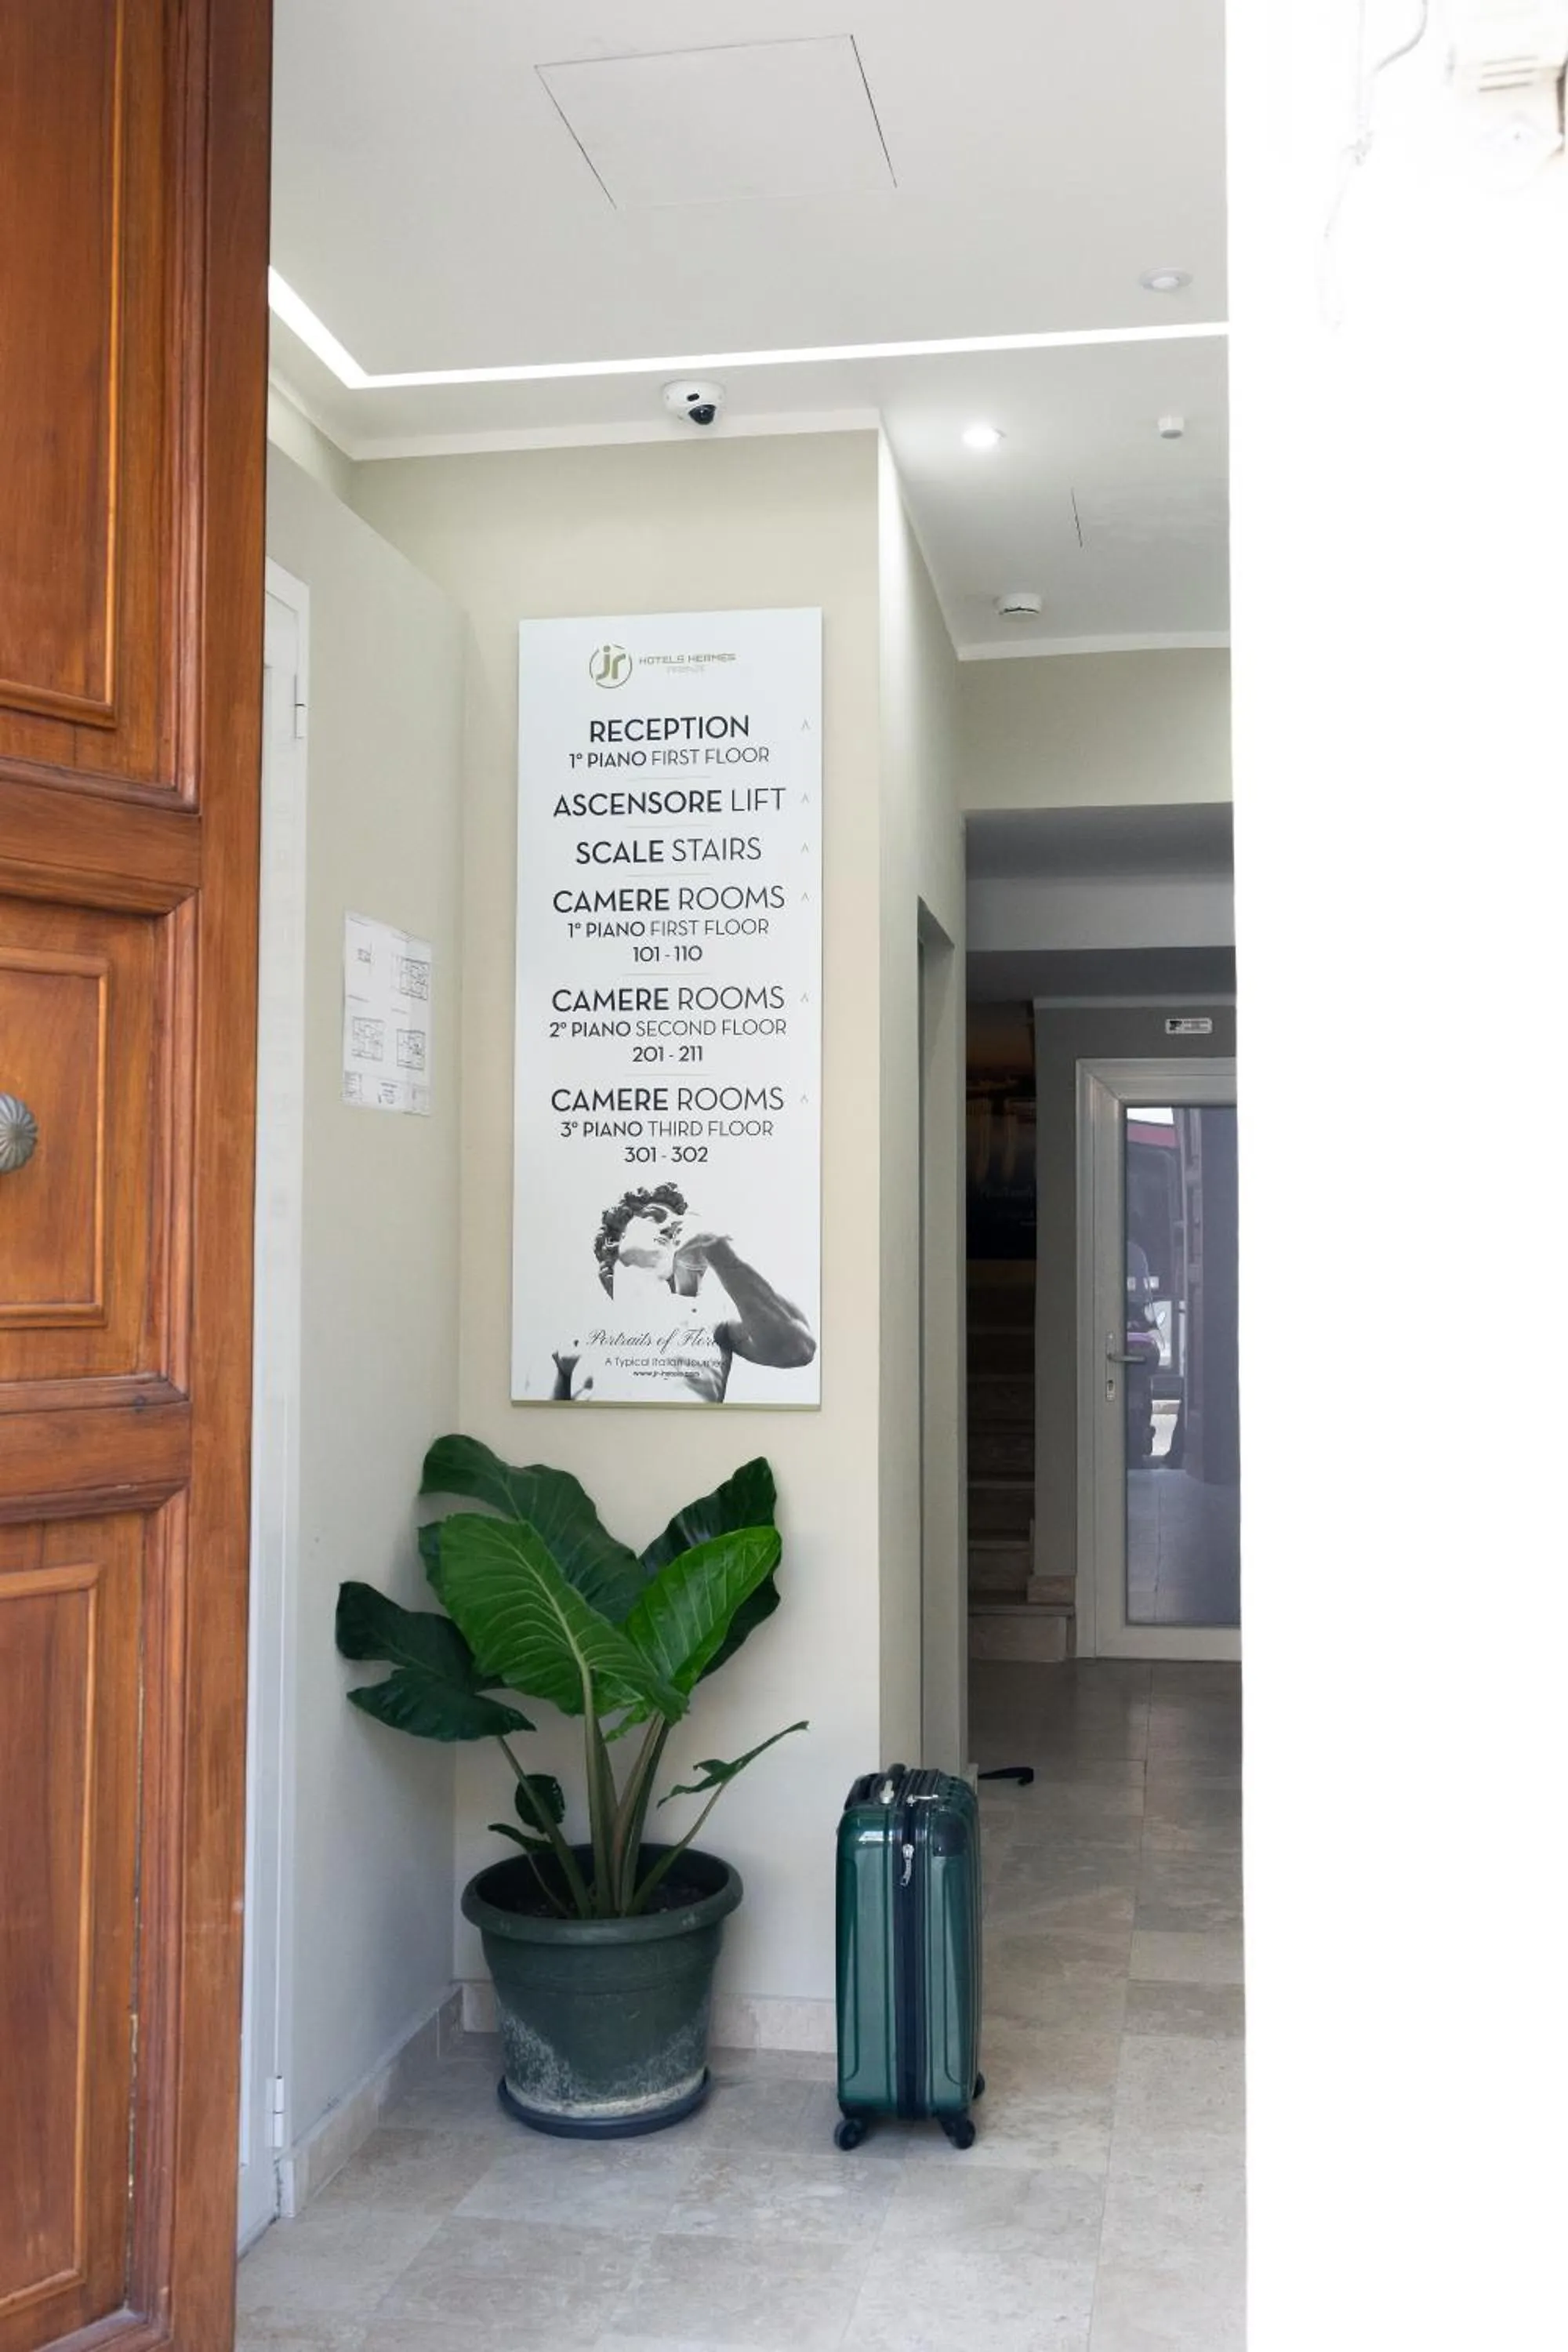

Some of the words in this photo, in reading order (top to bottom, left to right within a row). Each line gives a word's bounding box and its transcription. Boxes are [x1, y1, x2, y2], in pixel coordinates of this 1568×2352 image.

[590, 714, 749, 743] RECEPTION
[587, 750, 647, 768] PIANO
[652, 749, 700, 766] FIRST
[705, 746, 770, 764] FLOOR
[553, 789, 722, 818] ASCENSORE
[731, 787, 786, 812] LIFT
[575, 840, 664, 865] SCALE
[671, 837, 762, 862] STAIRS
[553, 887, 670, 913] CAMERE
[678, 885, 785, 910] ROOMS
[586, 920, 645, 938] PIANO
[650, 919, 700, 937] FIRST
[704, 918, 769, 935] FLOOR
[633, 946, 660, 963] 101
[673, 945, 703, 962] 110
[551, 987, 670, 1012] CAMERE
[678, 985, 785, 1011] ROOMS
[572, 1020, 631, 1038] PIANO
[635, 1019, 717, 1037] SECOND
[721, 1018, 787, 1036] FLOOR
[632, 1045, 664, 1062] 201
[678, 1045, 703, 1062] 211
[551, 1087, 669, 1112] CAMERE
[677, 1086, 785, 1111] ROOMS
[583, 1120, 644, 1138] PIANO
[647, 1120, 703, 1138] THIRD
[708, 1120, 774, 1137] FLOOR
[624, 1146, 656, 1163] 301
[670, 1145, 708, 1163] 302
[587, 1329, 652, 1347] Portraits
[656, 1328, 679, 1354] of
[677, 1327, 718, 1346] Flor
[604, 1358, 612, 1367] A
[614, 1357, 650, 1369] Typical
